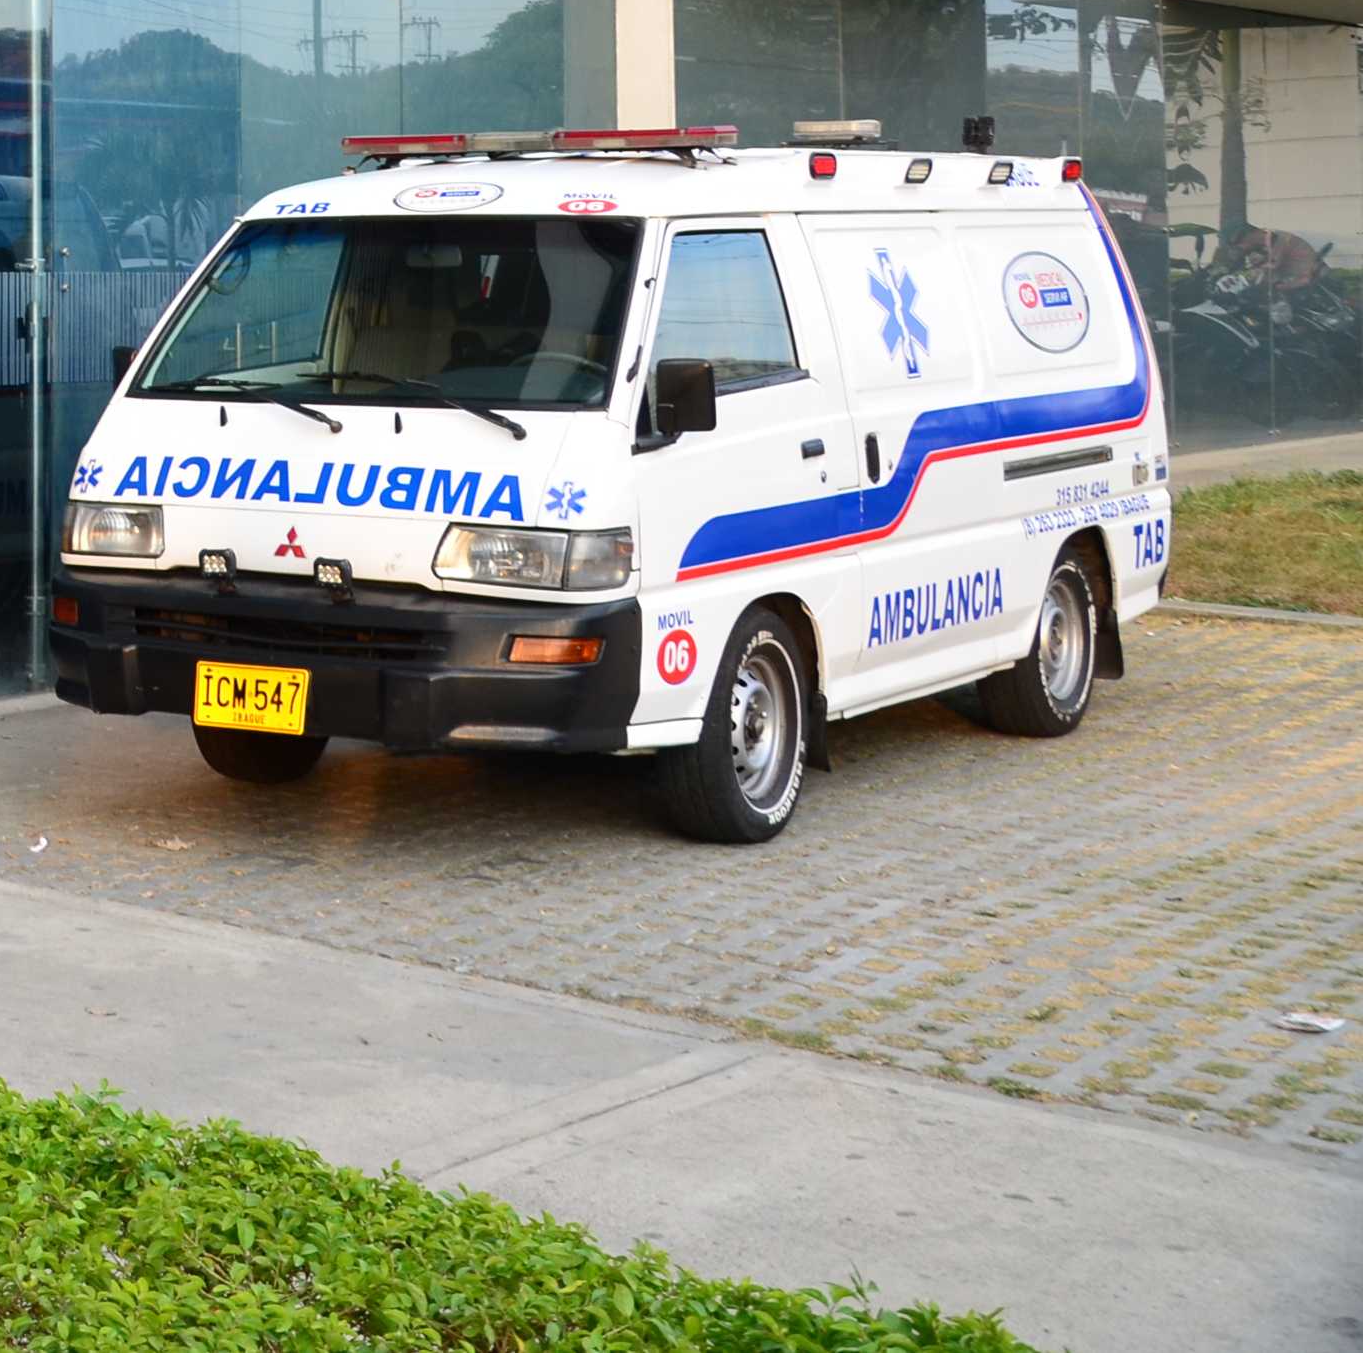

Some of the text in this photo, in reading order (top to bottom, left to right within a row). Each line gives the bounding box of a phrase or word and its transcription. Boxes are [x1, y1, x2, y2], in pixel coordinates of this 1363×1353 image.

[276, 202, 331, 215] TAB
[567, 199, 606, 212] 06
[1133, 518, 1164, 569] TAB
[868, 567, 1003, 648] AMBULANCIA
[658, 610, 694, 630] MOVIL
[663, 639, 690, 674] 06
[232, 711, 266, 725] IBAGUE
